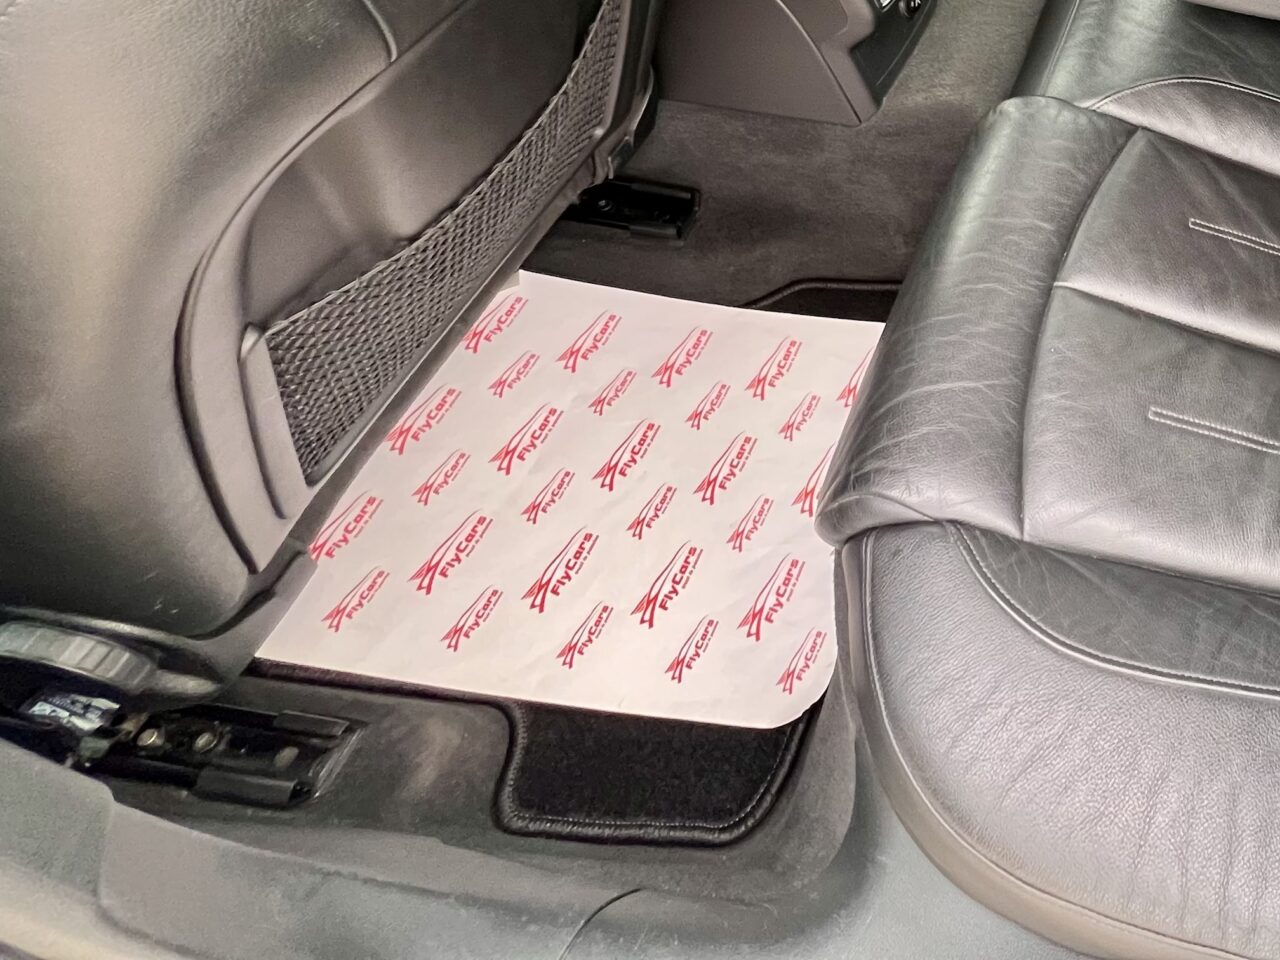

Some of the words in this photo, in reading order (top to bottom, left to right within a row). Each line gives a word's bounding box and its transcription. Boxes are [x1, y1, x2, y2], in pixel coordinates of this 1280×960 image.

[410, 387, 457, 442] FlyCars
[516, 407, 558, 462] FlyCars
[618, 422, 655, 477] FlyCars
[718, 435, 752, 490] FlyCars
[324, 495, 377, 558] FlyCars
[438, 515, 487, 578] FlyCars
[550, 532, 594, 596] FlyCars
[658, 546, 697, 611] FlyCars
[764, 559, 799, 624] FlyCars
[345, 570, 386, 620] FlyCars
[462, 589, 499, 639] FlyCars
[576, 605, 609, 656] FlyCars
[685, 619, 715, 670] FlyCars
[795, 630, 823, 681] FlyCars
